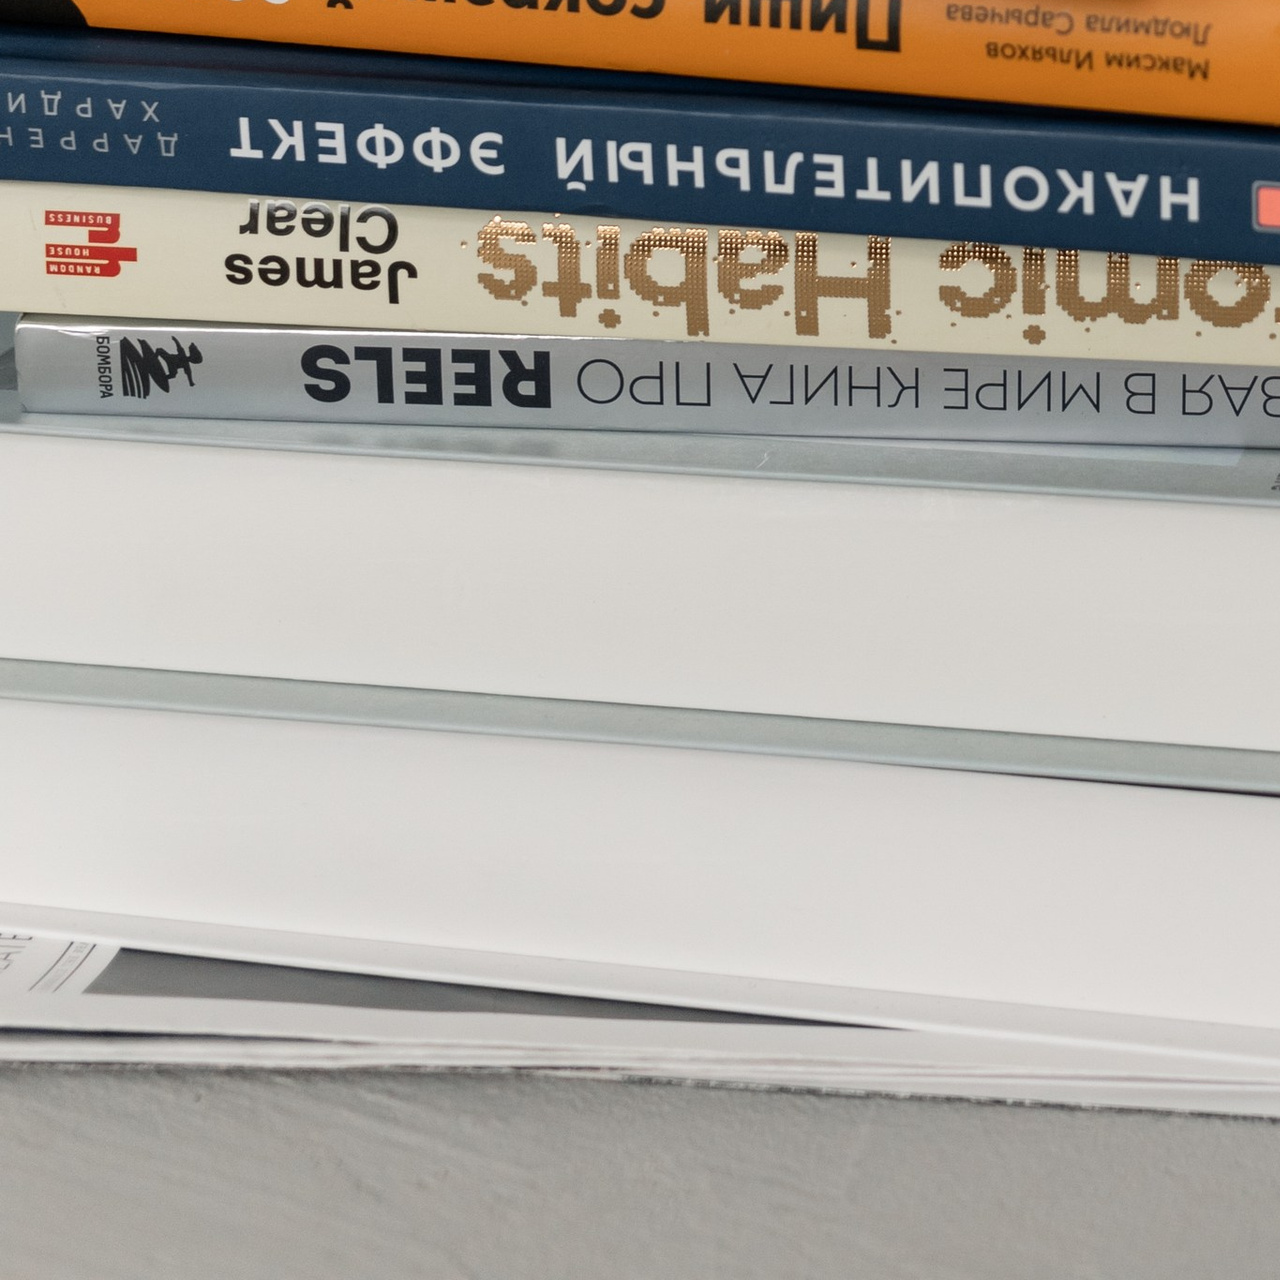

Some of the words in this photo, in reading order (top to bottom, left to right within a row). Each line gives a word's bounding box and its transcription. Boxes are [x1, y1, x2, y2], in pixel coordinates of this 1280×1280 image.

[946, 3, 1074, 36] Сарычева
[1084, 13, 1214, 47] Людмила
[985, 42, 1094, 72] Ильяхов
[1104, 51, 1210, 81] Максим
[7, 90, 160, 123] ХАРДИ
[229, 116, 505, 175] ЭФФЕКТ
[555, 136, 1200, 222] НАКОПИТЕЛЬНЫЙ
[48, 213, 112, 225] BUSINESS
[239, 198, 399, 255] Clear
[48, 246, 90, 257] HOUSE
[49, 263, 101, 275] RANDOM
[224, 252, 418, 305] James
[477, 219, 892, 338] Habits
[96, 335, 114, 399] БОМБОРА
[300, 344, 552, 409] REELS
[577, 358, 711, 407] ПРО
[732, 362, 919, 408] КНИГА
[943, 368, 1100, 413] МИРЕ
[1123, 372, 1156, 415] В
